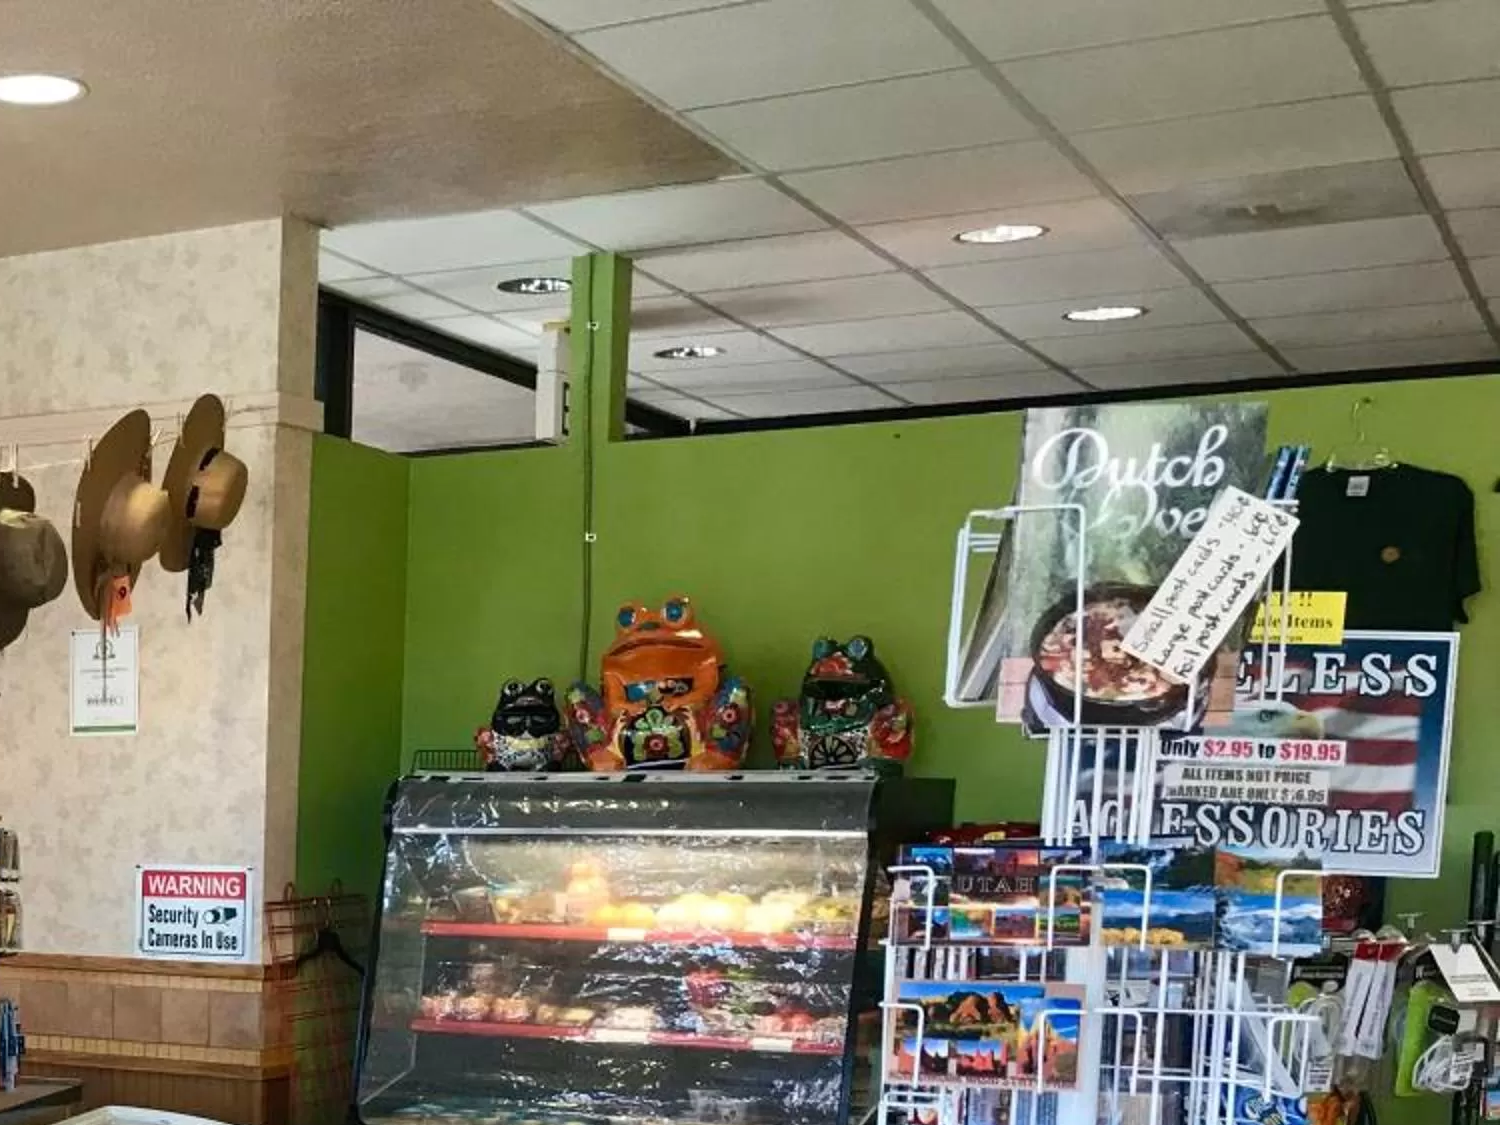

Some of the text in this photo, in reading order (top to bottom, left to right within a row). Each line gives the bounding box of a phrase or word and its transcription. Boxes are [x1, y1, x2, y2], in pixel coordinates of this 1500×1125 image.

[1032, 424, 1228, 489] Dutch
[1287, 614, 1333, 629] Items
[1154, 623, 1191, 666] Large
[1160, 739, 1341, 761] Only $2.95 to $19.95
[1181, 767, 1312, 785] ALL ITEMS NOT PRICE
[147, 874, 241, 897] WARNING
[957, 876, 1034, 894] UTAH
[148, 903, 199, 928] Security
[148, 928, 238, 951] Cameras In Use
